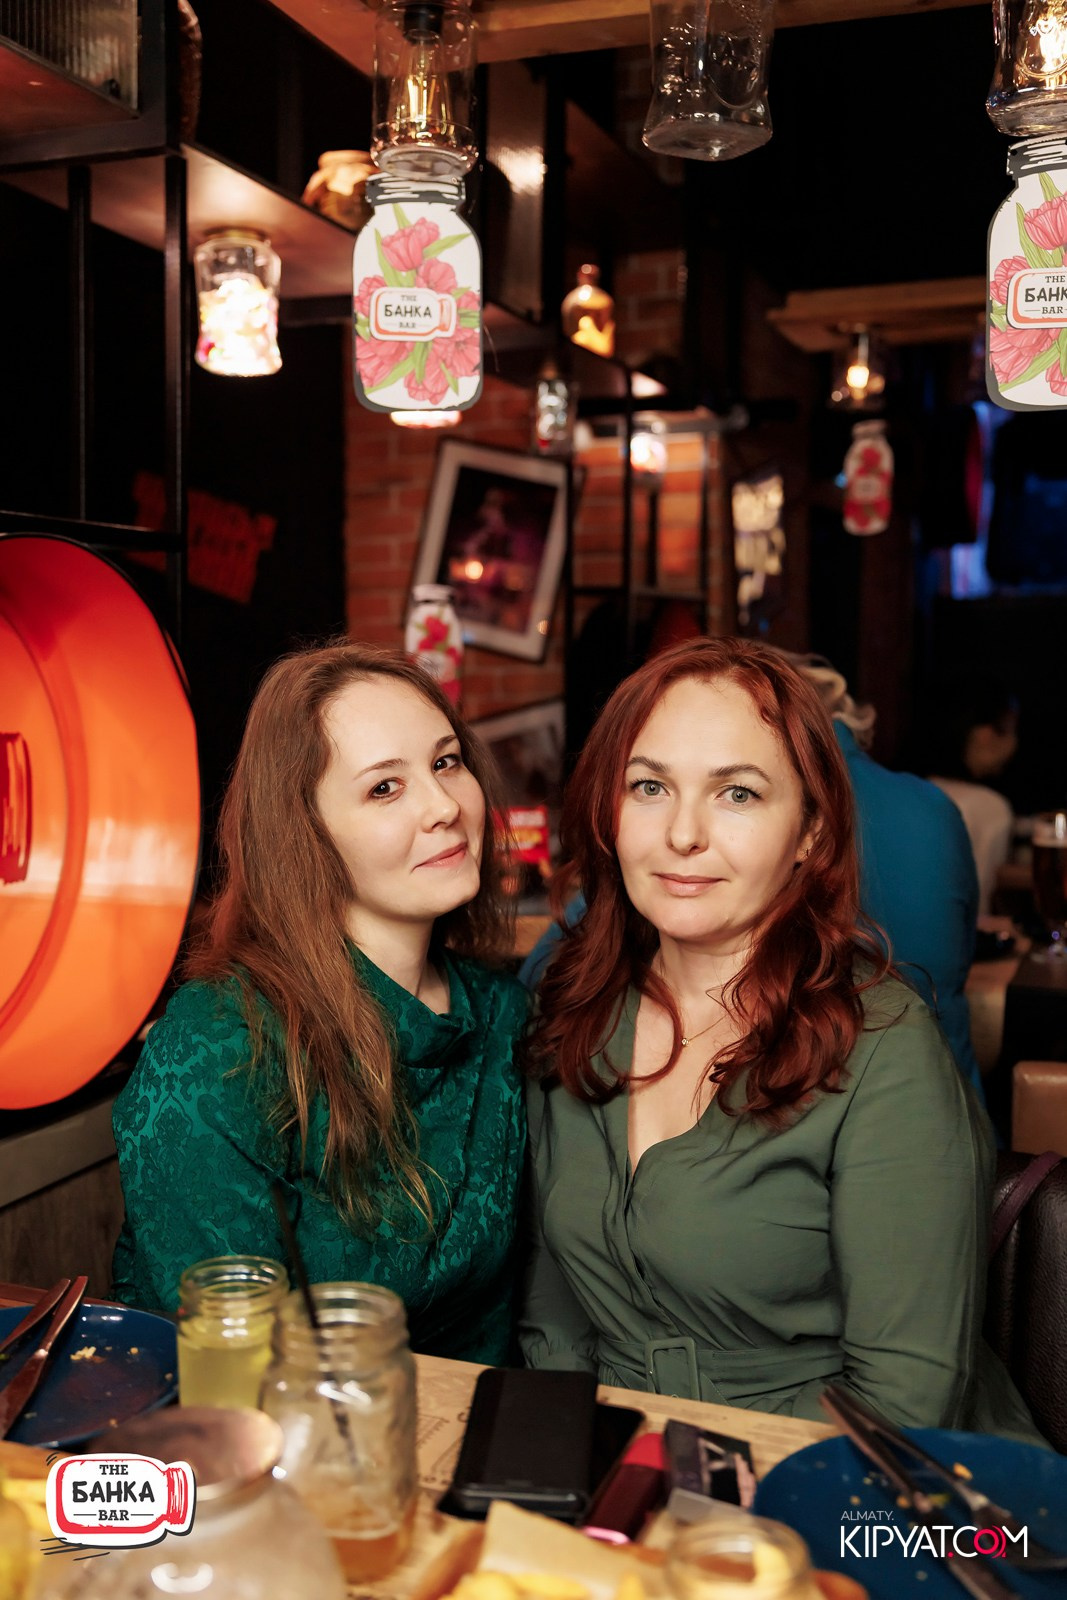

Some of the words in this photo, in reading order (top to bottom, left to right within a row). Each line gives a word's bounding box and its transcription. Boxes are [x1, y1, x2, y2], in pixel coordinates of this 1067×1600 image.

[1045, 275, 1066, 283] THE
[384, 304, 432, 318] БАНКА
[1042, 306, 1063, 314] BAR
